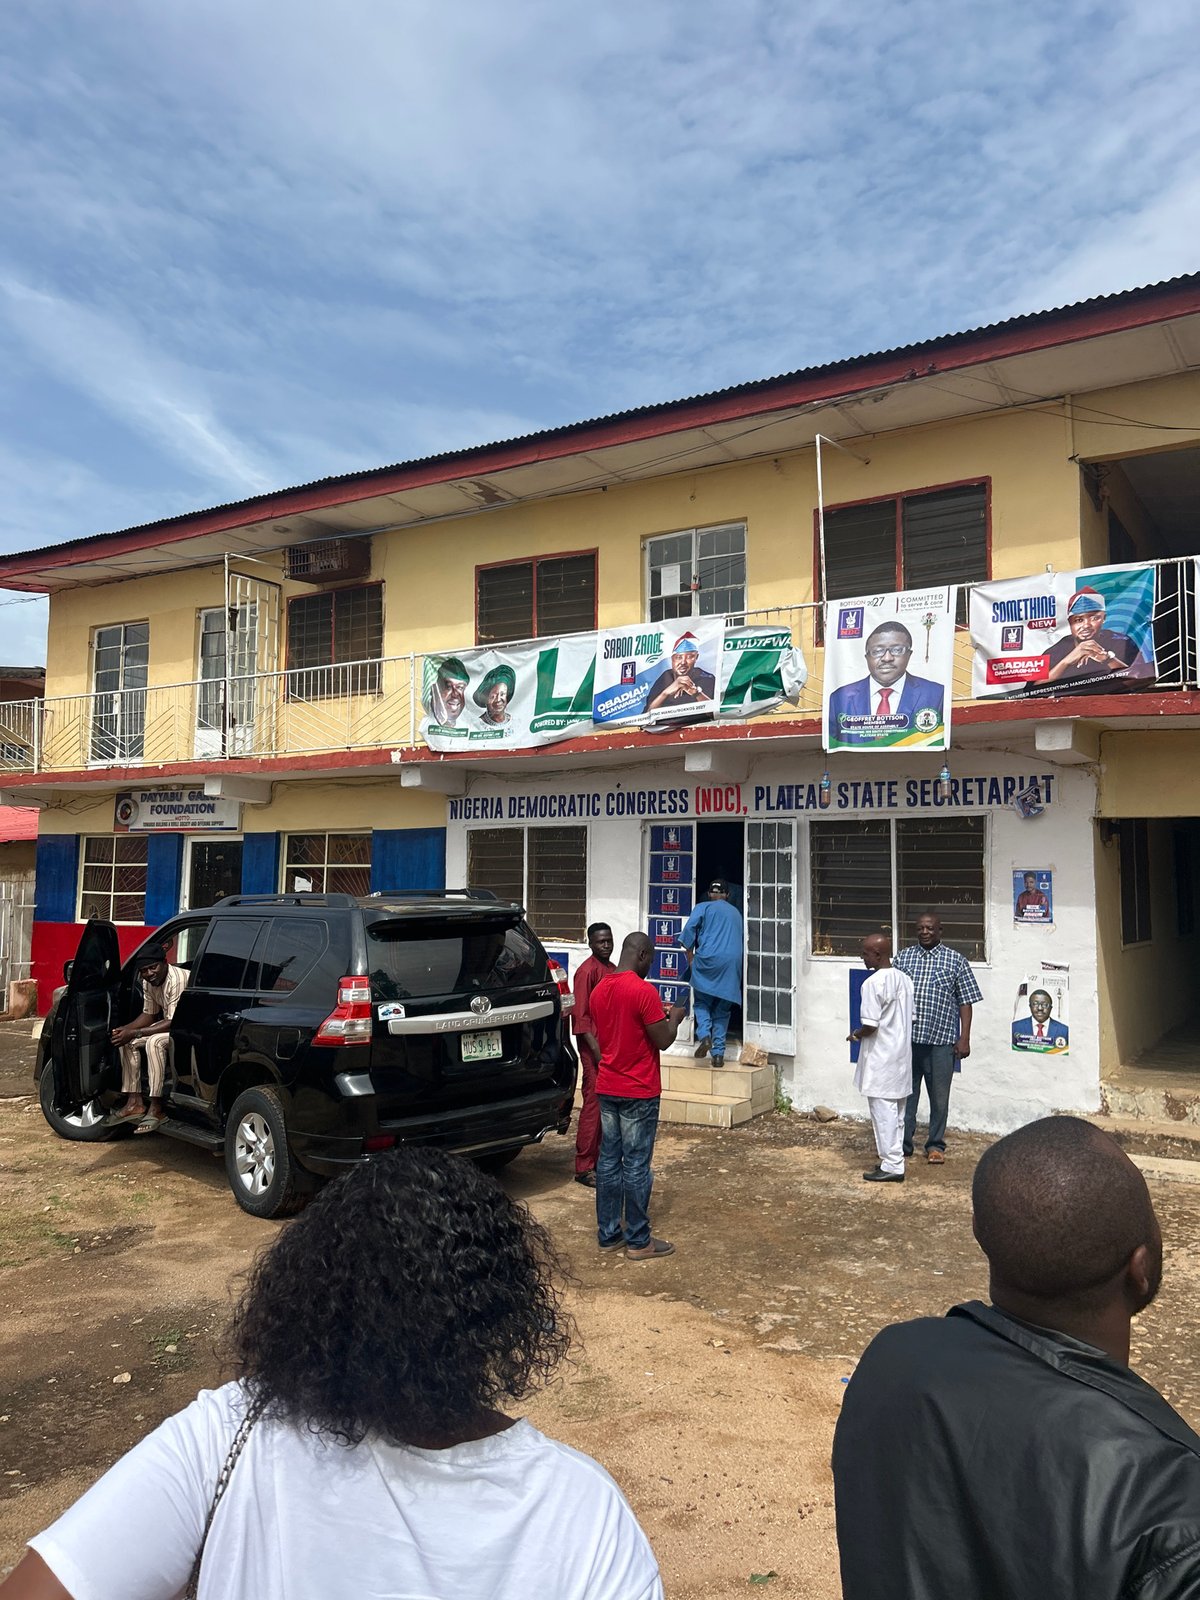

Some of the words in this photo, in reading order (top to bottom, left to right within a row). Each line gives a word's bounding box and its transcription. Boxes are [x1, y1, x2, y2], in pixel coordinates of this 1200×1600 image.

[840, 600, 866, 608] BOTTSON
[867, 596, 885, 607] 2027
[900, 594, 944, 604] COMMITTED
[992, 595, 1056, 624] SOMETHING
[1032, 620, 1054, 628] NEW
[604, 636, 633, 660] SABON
[992, 660, 1044, 671] OBADIAH
[1030, 683, 1069, 696] REPRESENTING
[597, 682, 649, 712] OBADIAH
[534, 718, 555, 728] POWERED
[140, 792, 183, 802] DAYYABU
[450, 796, 503, 820] NIGERIA
[508, 792, 600, 819] DEMOCRATIC
[606, 788, 689, 816] CONGRESS
[755, 784, 832, 811] PLATEAU
[838, 780, 898, 810] STATE
[150, 803, 216, 815] FOUNDATION
[656, 936, 674, 944] NDC
[436, 1020, 461, 1030] LAND
[463, 1016, 501, 1026] CRUISER
[502, 1012, 528, 1022] PRADO
